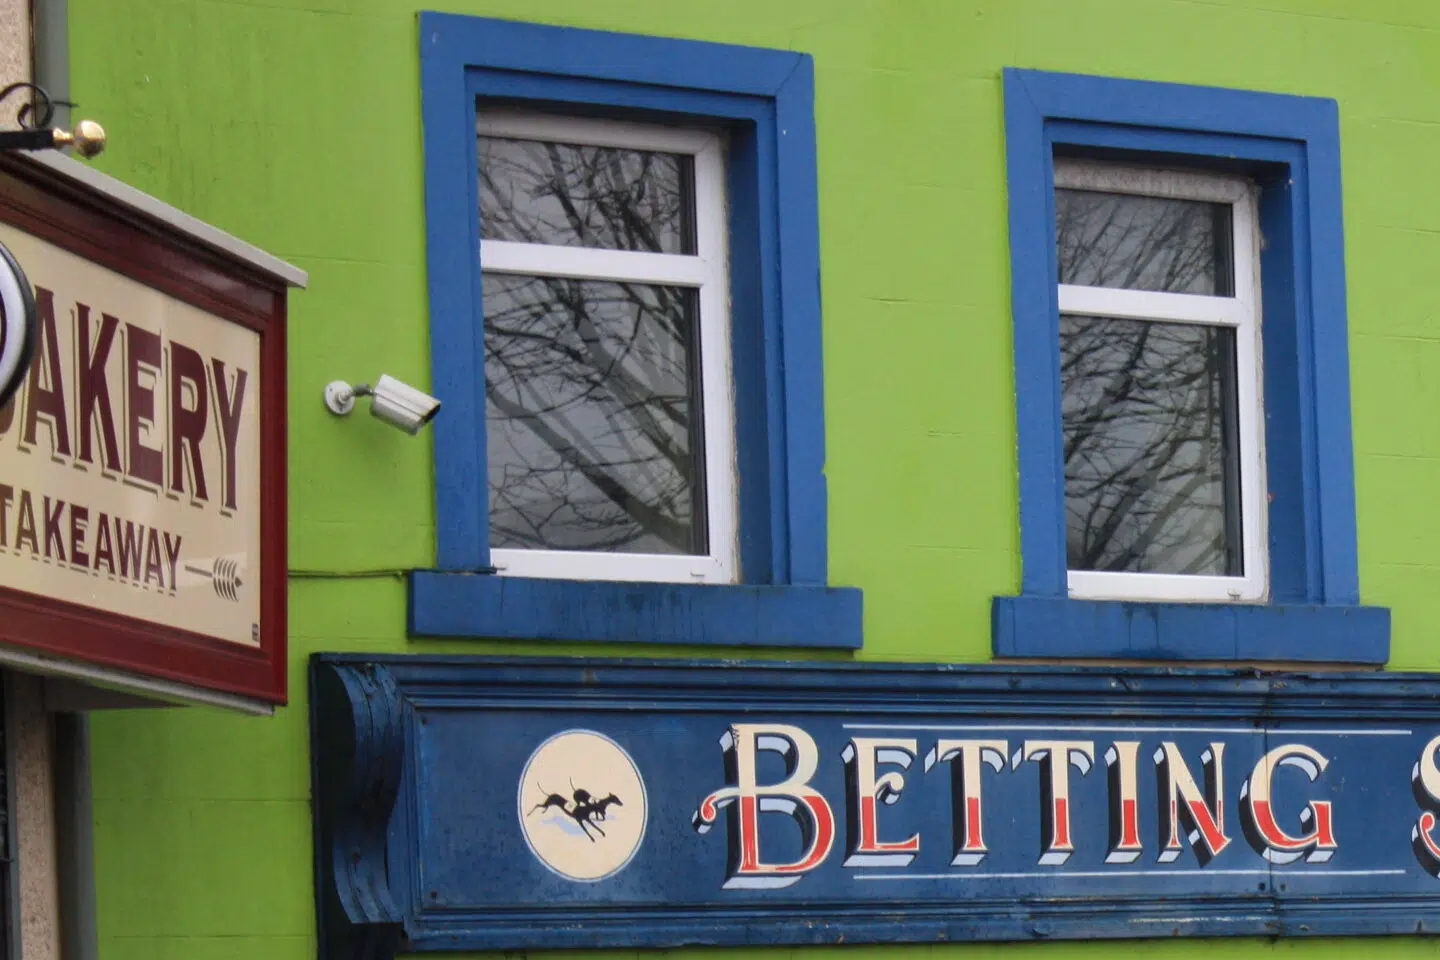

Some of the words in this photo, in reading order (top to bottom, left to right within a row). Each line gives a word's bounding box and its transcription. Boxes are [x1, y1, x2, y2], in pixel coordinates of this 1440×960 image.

[0, 284, 248, 513] AKERY
[0, 484, 182, 593] TAKEAWAY
[693, 721, 1339, 888] BETTING
